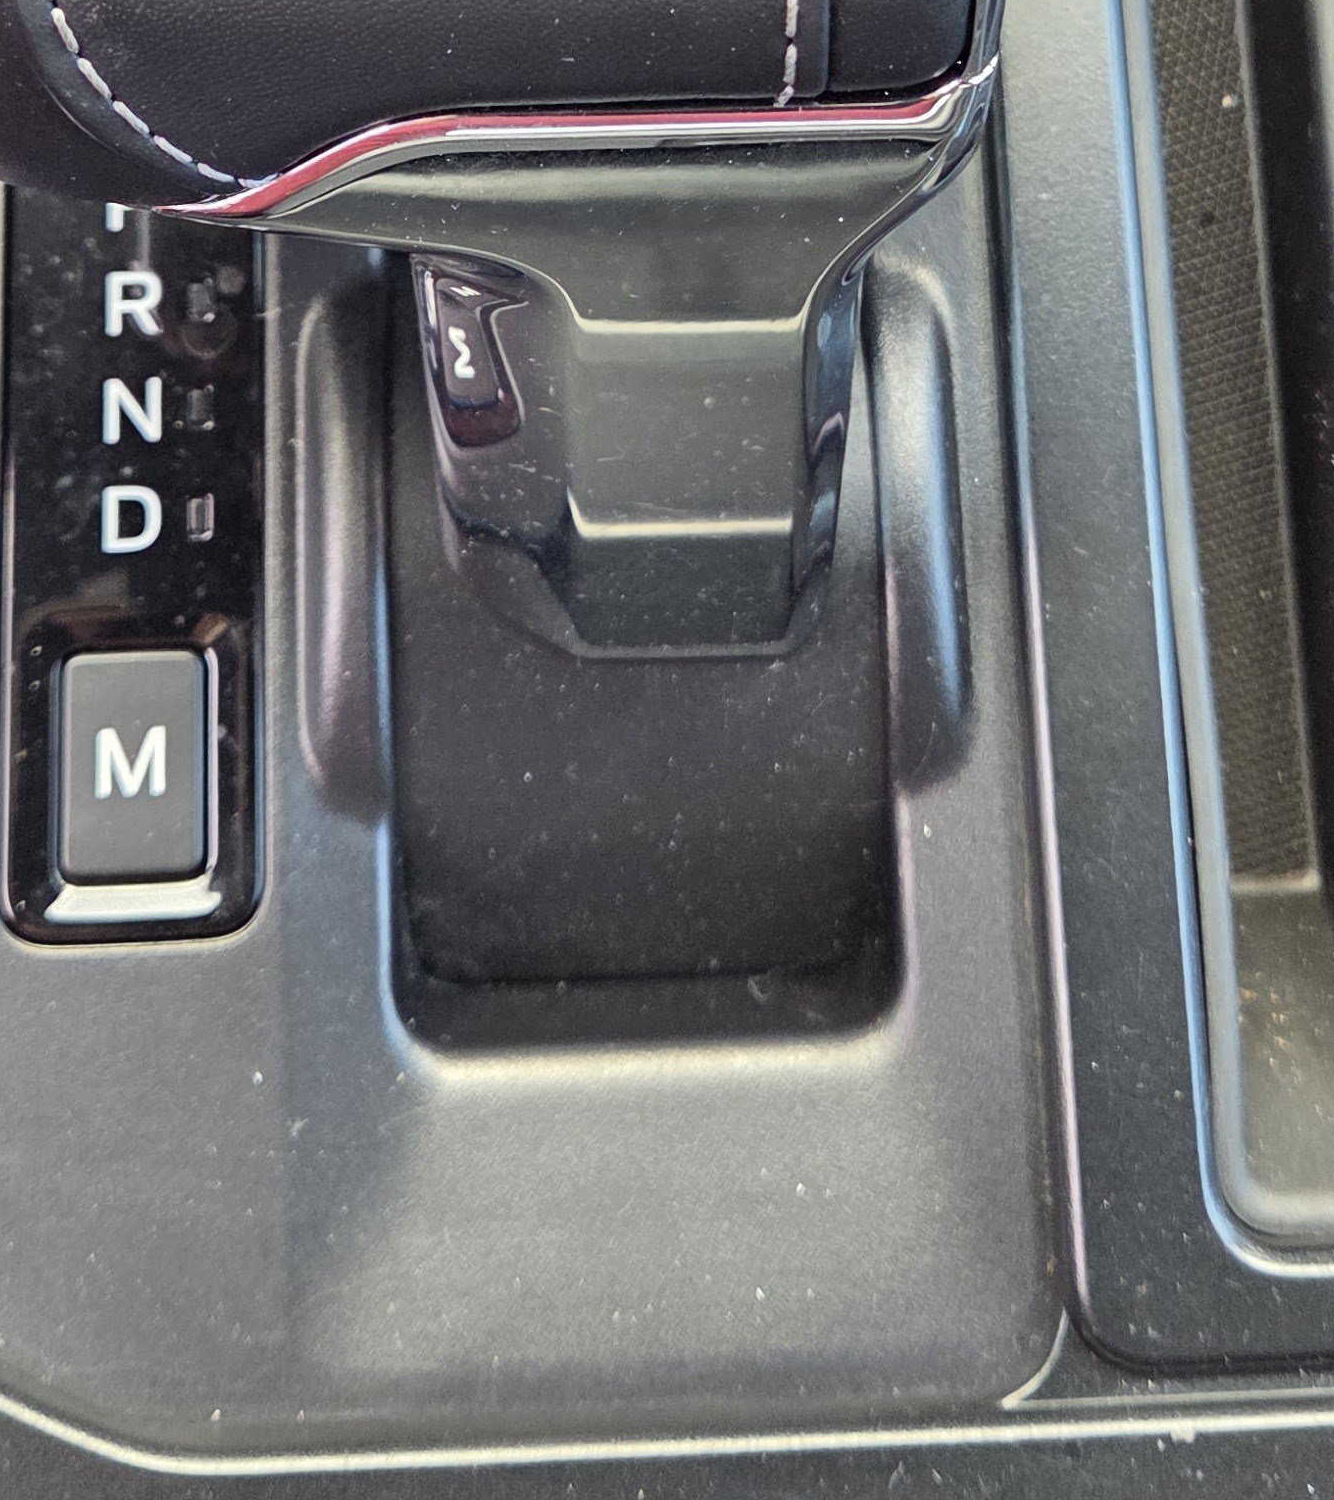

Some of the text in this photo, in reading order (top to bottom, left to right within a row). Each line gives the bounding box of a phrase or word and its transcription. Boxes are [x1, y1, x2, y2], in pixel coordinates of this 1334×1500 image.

[105, 271, 163, 337] R
[103, 377, 163, 444] N
[101, 485, 162, 554] D
[94, 726, 168, 799] M
